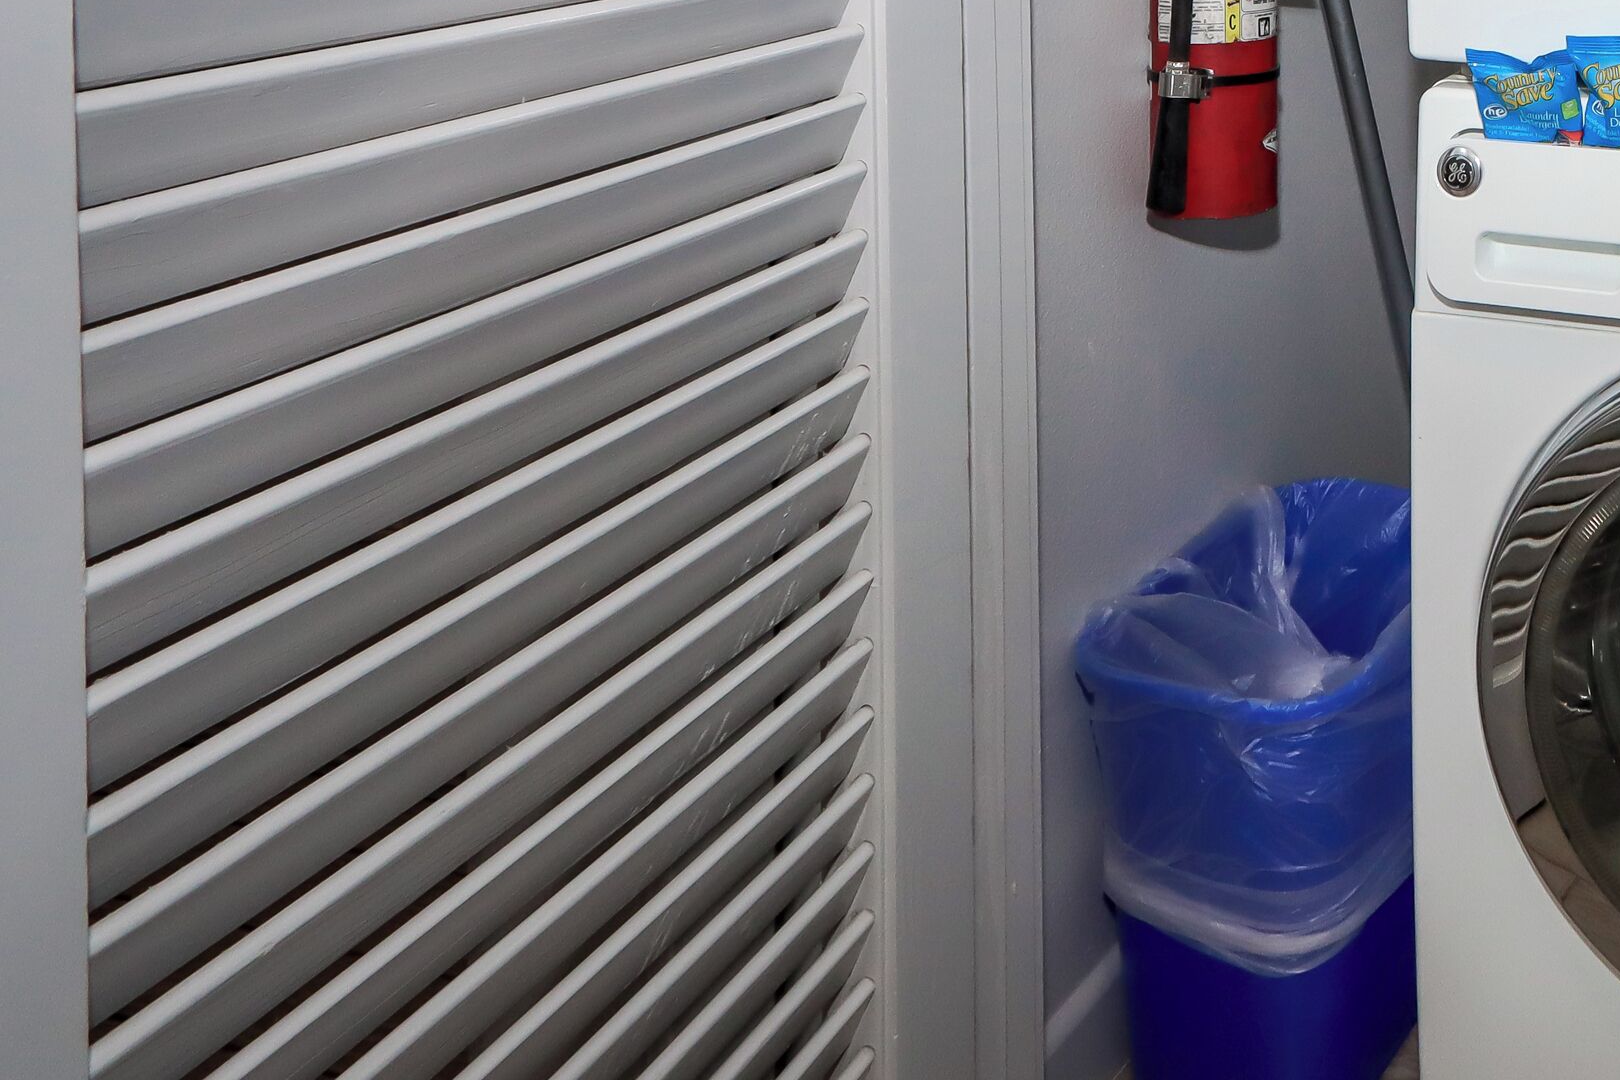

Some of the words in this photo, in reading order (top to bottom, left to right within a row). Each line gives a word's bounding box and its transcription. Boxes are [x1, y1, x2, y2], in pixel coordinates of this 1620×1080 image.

[1229, 14, 1237, 31] C
[1483, 66, 1556, 94] Country
[1501, 82, 1554, 111] Save
[1520, 109, 1559, 123] Laundry
